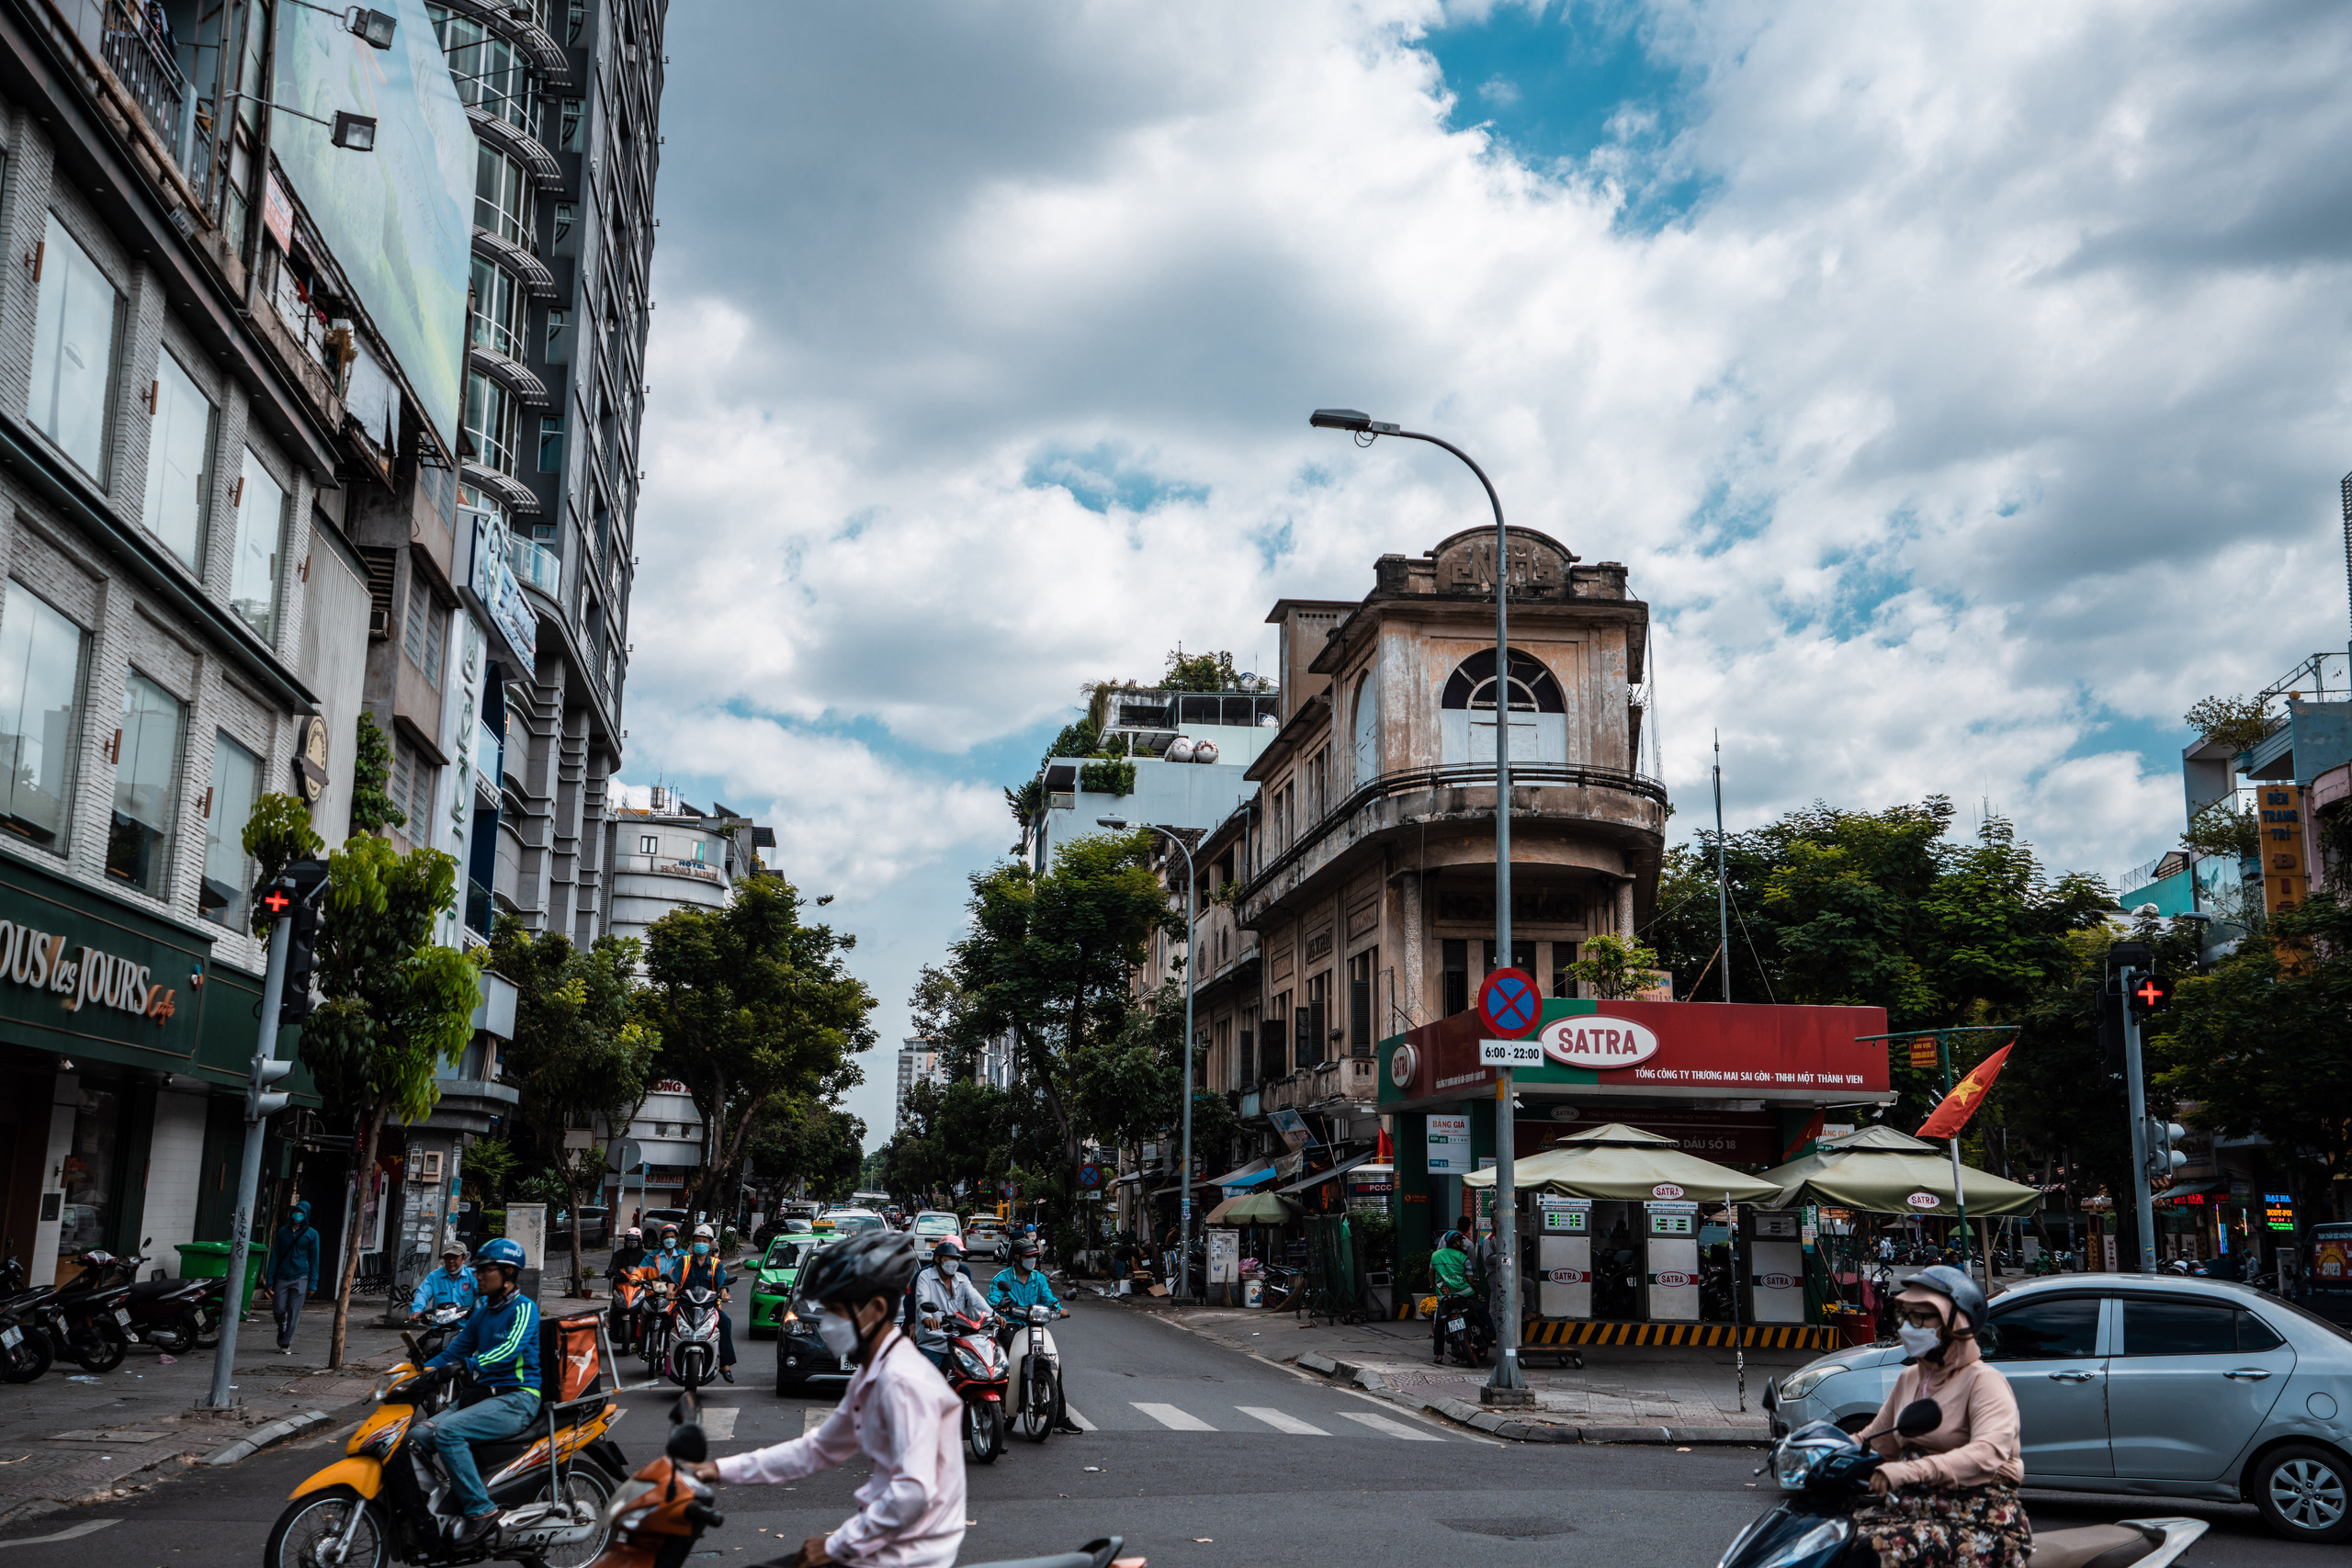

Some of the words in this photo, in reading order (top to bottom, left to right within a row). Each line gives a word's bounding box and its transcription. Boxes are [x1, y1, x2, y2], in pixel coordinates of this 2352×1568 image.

[2267, 788, 2289, 805] ĐÈN
[2262, 809, 2298, 823] TRANG
[2271, 825, 2290, 840] TRÍ
[679, 861, 706, 870] HOTEL
[695, 869, 718, 881] MINH
[51, 936, 77, 994] les
[74, 946, 151, 1015] JOURS
[1557, 1027, 1638, 1055] SATRA
[1485, 1047, 1506, 1058] 6:00
[1513, 1048, 1540, 1059] 22:00
[1393, 1055, 1408, 1077] SATRA
[1635, 1066, 1655, 1078] TỔNG
[1657, 1067, 1677, 1079] CÔNG
[1679, 1070, 1689, 1079] TY
[1691, 1069, 1722, 1080] THƯƠNG
[1754, 1070, 1770, 1081] GÒN
[1775, 1073, 1795, 1082] TNHH
[1797, 1071, 1815, 1084] MỘT
[1817, 1072, 1843, 1084] THÀNH
[1432, 1118, 1452, 1129] BẢNG
[1453, 1119, 1465, 1129] GIÁ
[1683, 1135, 1706, 1149] DẦU
[1708, 1136, 1724, 1149] SỐ
[1725, 1140, 1736, 1149] 18
[656, 1174, 684, 1183] MINH
[1656, 1188, 1680, 1196] SATRA
[1911, 1195, 1936, 1205] SATRA
[2323, 1262, 2341, 1277] 2023
[1554, 1272, 1577, 1280] SATRA
[1661, 1275, 1684, 1283] SATRA
[1766, 1277, 1789, 1286] SATRA
